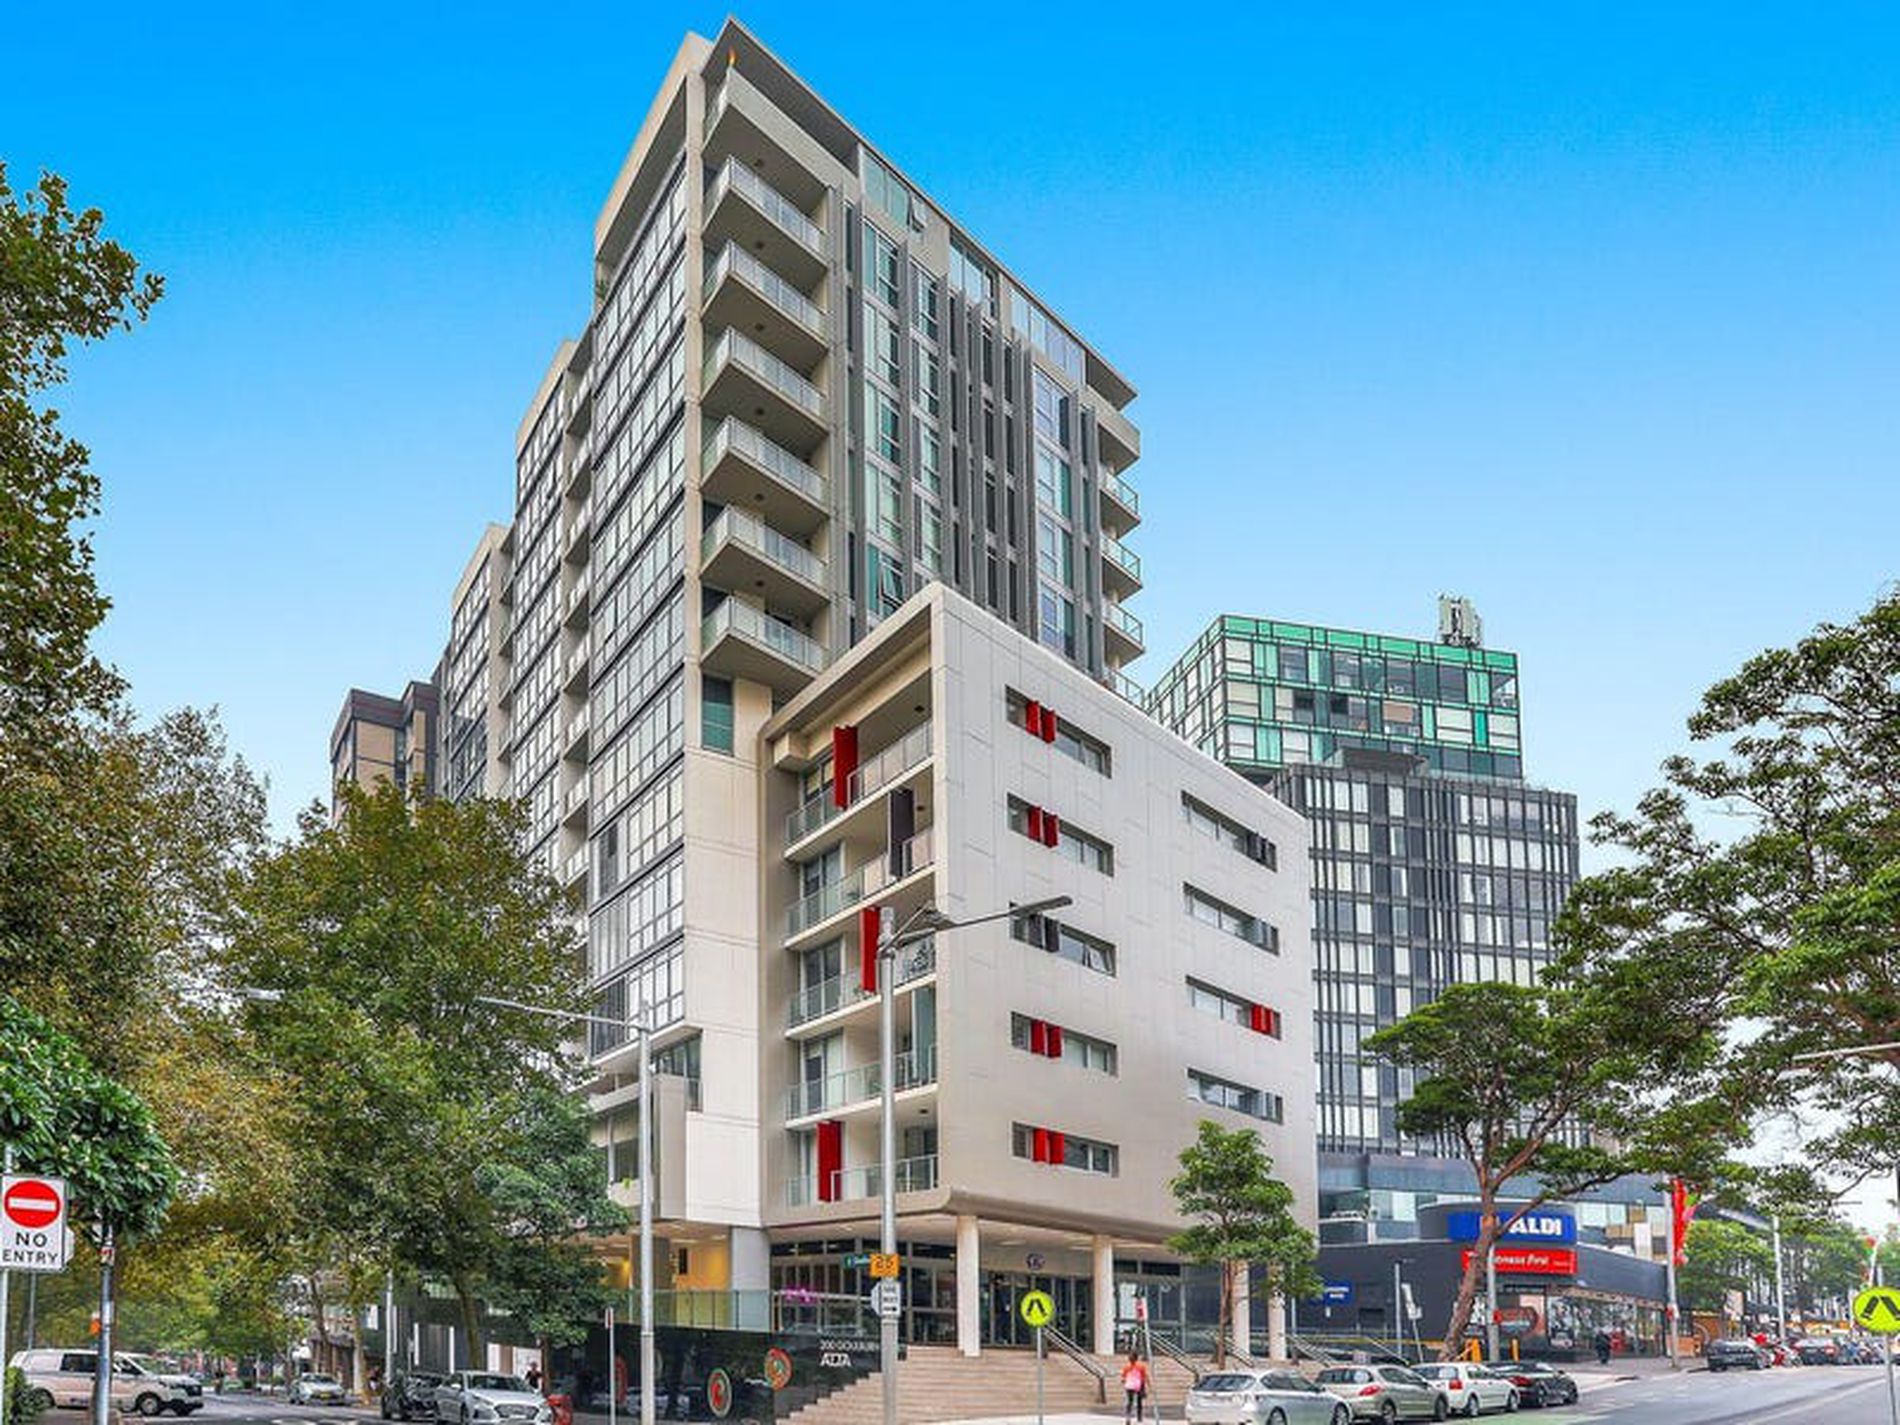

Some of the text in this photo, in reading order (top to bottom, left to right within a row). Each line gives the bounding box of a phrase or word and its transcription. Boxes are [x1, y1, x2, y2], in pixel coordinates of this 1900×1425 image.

[1509, 1217, 1562, 1235] ALDI
[16, 1232, 47, 1247] NO
[3, 1249, 59, 1264] ENTRY
